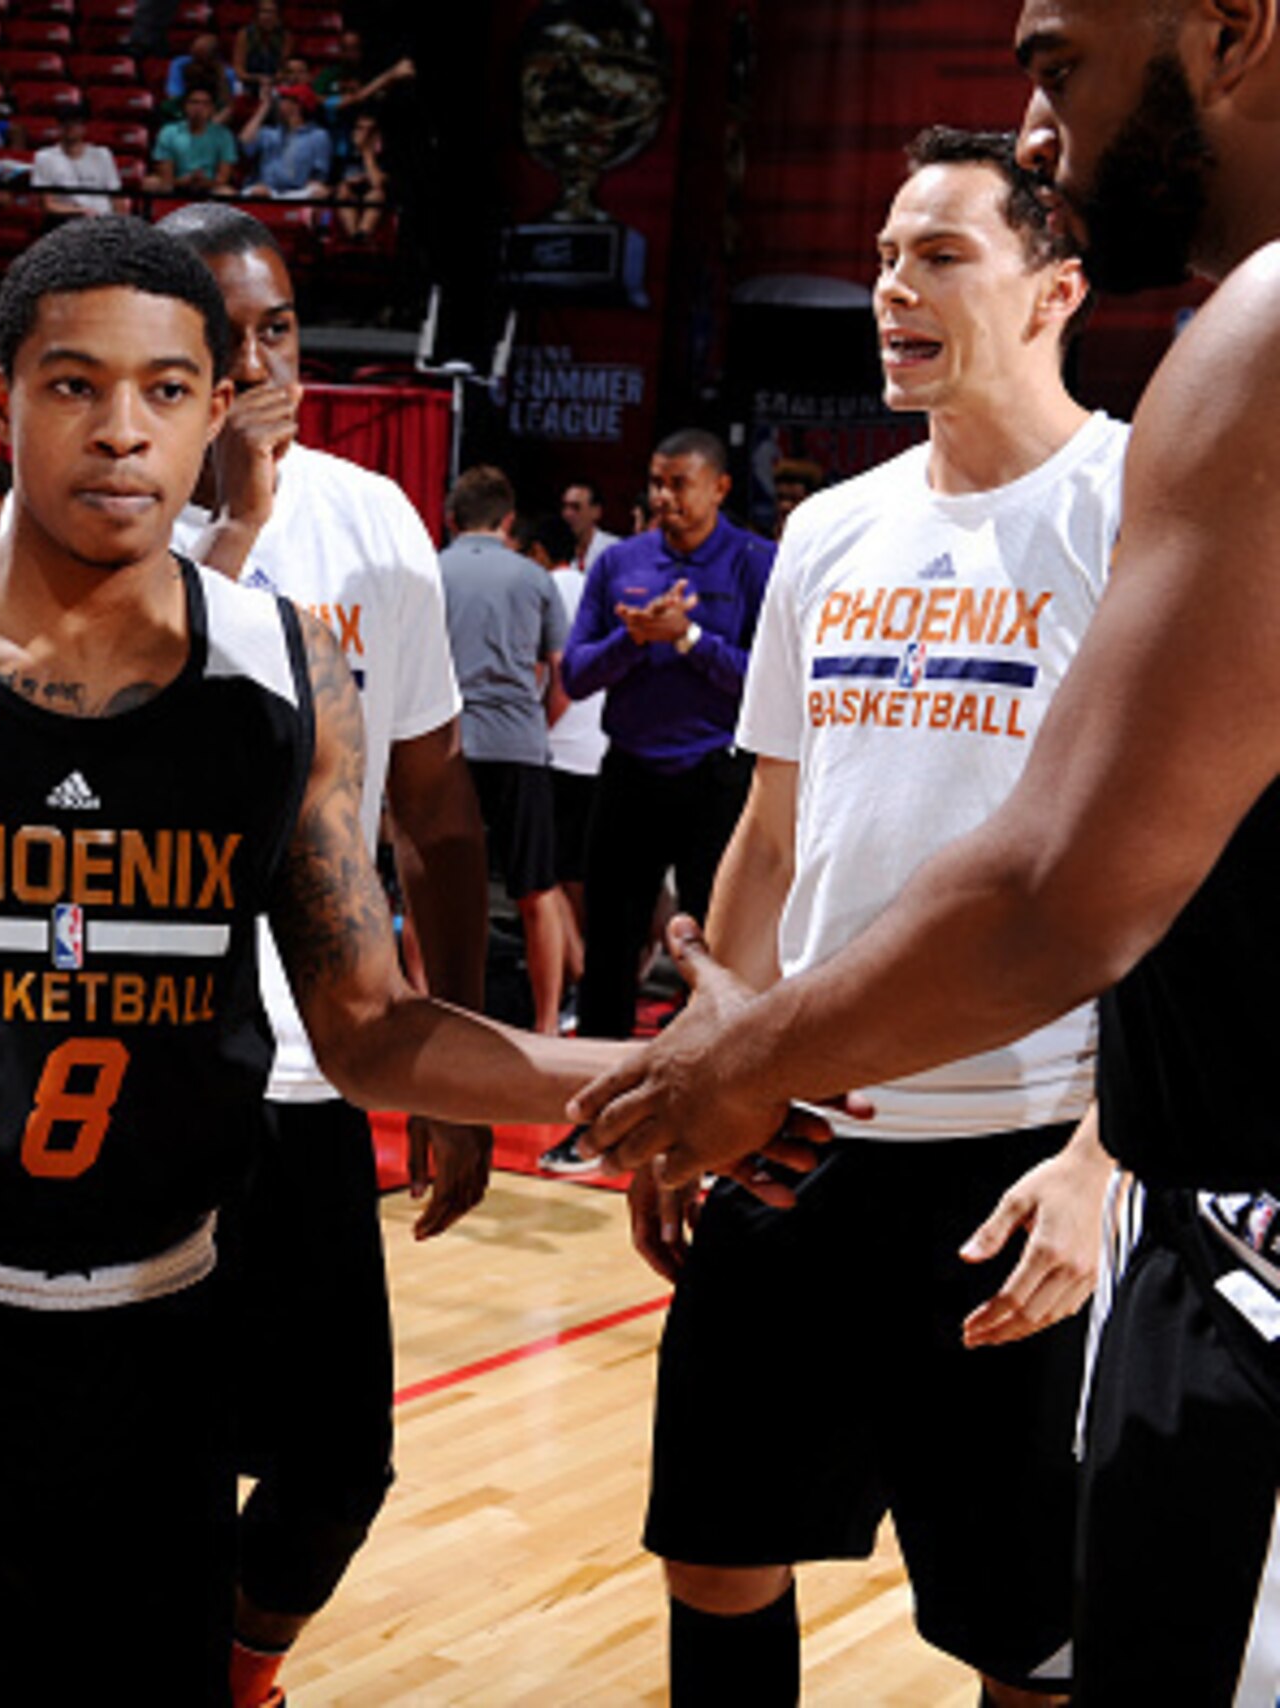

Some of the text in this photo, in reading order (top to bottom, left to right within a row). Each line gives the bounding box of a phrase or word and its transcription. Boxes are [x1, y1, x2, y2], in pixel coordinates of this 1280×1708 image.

[513, 367, 644, 404] SUMMER
[508, 401, 624, 437] LEAGUE
[816, 587, 1054, 649] PHOENIX
[808, 688, 1026, 739] BASKETBALL
[20, 1037, 130, 1179] 8
